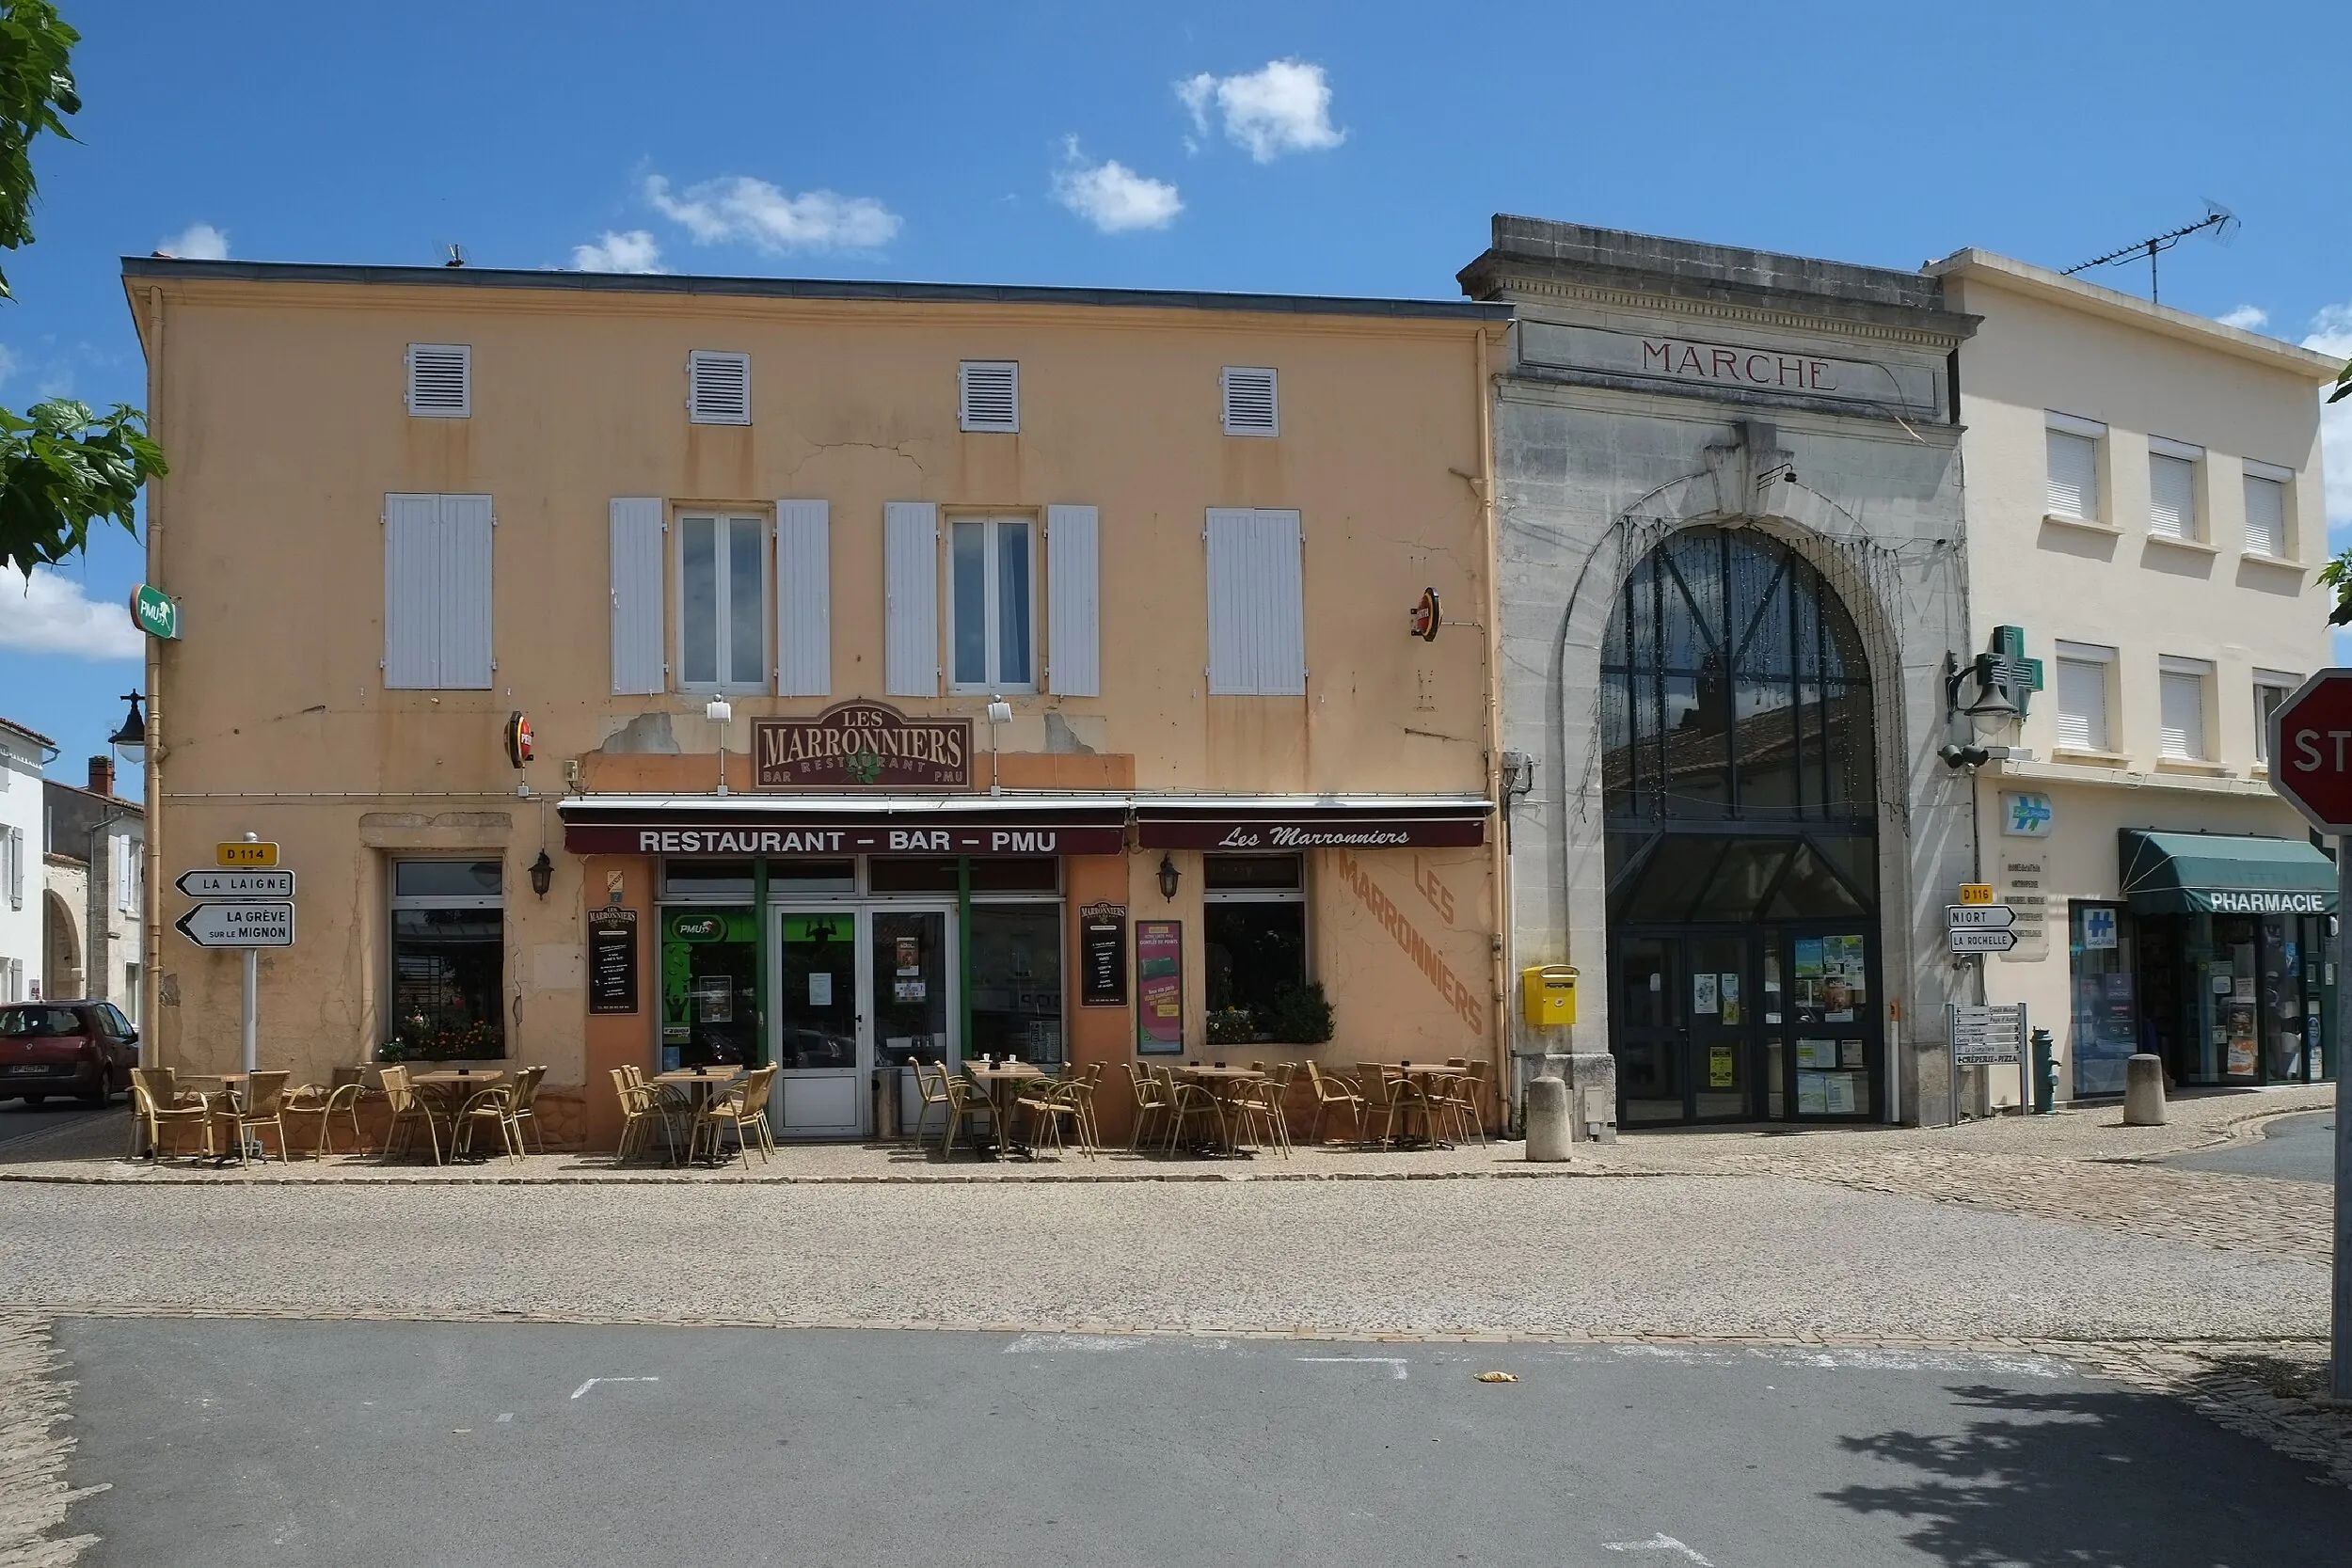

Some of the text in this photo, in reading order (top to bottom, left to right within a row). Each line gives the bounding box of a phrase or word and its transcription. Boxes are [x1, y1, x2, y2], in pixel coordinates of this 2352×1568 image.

[140, 599, 159, 621] PMU
[842, 711, 883, 727] LES
[763, 728, 961, 768] MARRONNIERS
[801, 755, 926, 774] RESTAURANT
[763, 770, 791, 783] BAR
[934, 770, 963, 783] PMU
[640, 832, 846, 852] RESTAURANT
[889, 831, 950, 850] BAR
[992, 832, 1057, 851] PMU
[1218, 826, 1410, 847] Les Marronniers
[227, 849, 264, 860] D 114
[203, 879, 287, 889] LA LAIGNE
[1414, 854, 1454, 925] LES
[1963, 890, 1989, 900] D 116
[2211, 893, 2326, 912] PHARMACIE
[227, 909, 286, 923] LA GRÈVE
[590, 911, 636, 923] MARRONNIERS
[1081, 907, 1125, 917] MARRONNIERS
[1952, 911, 1987, 923] NIORT
[238, 927, 286, 938] MIGNON
[680, 925, 702, 934] PMU
[1953, 936, 2008, 946] LA ROCHELLE
